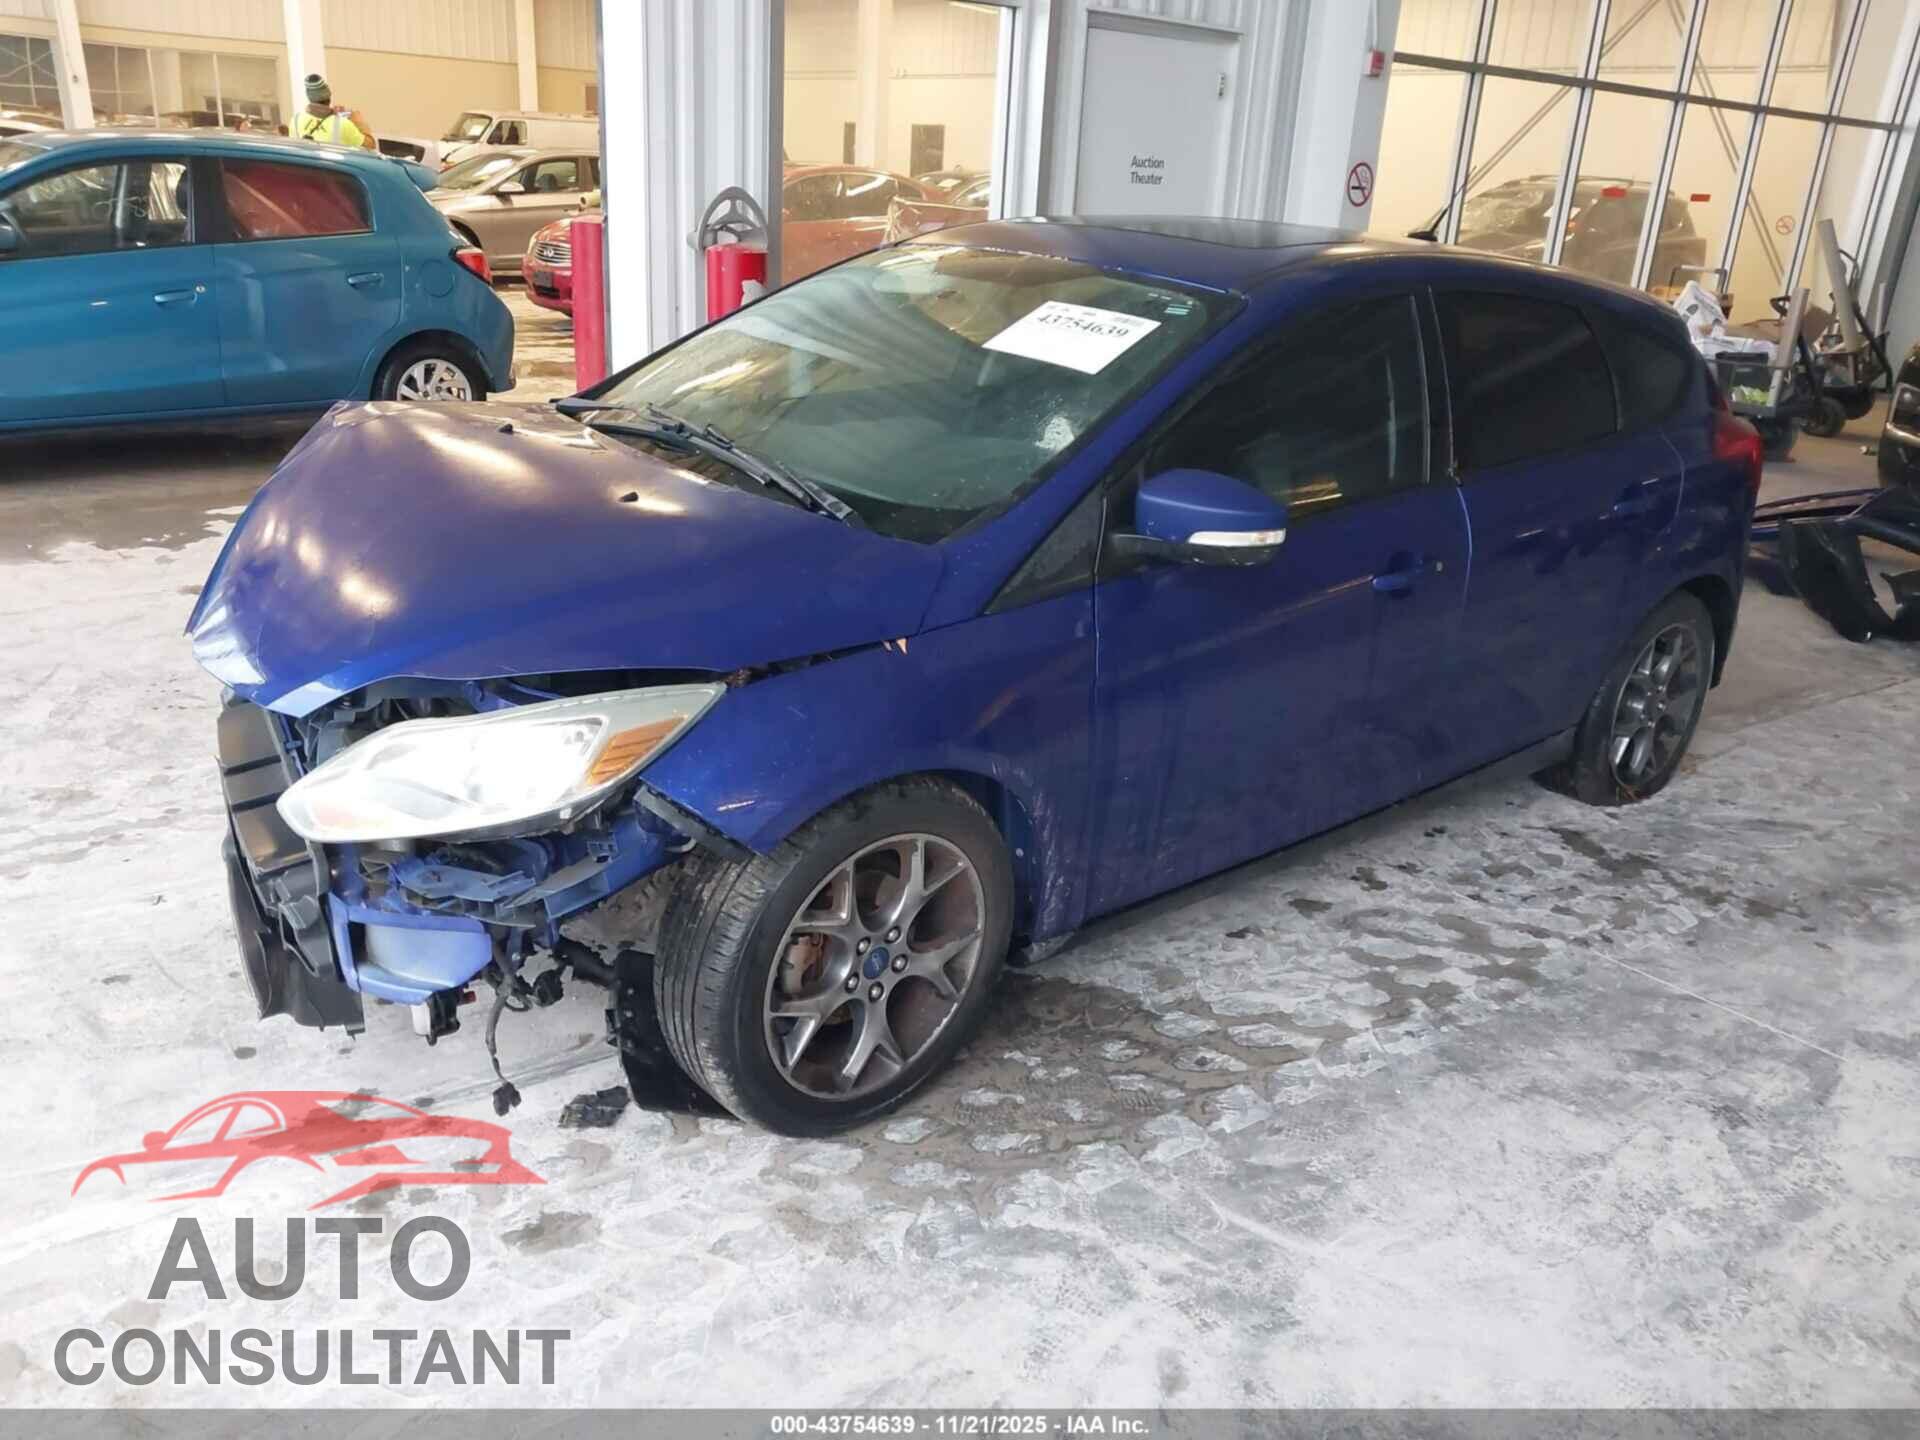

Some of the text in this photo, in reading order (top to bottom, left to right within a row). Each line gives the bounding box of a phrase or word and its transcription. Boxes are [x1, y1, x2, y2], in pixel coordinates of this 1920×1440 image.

[1131, 155, 1165, 168] Auction
[1130, 171, 1163, 185] Theater
[1036, 313, 1130, 337] 43754639
